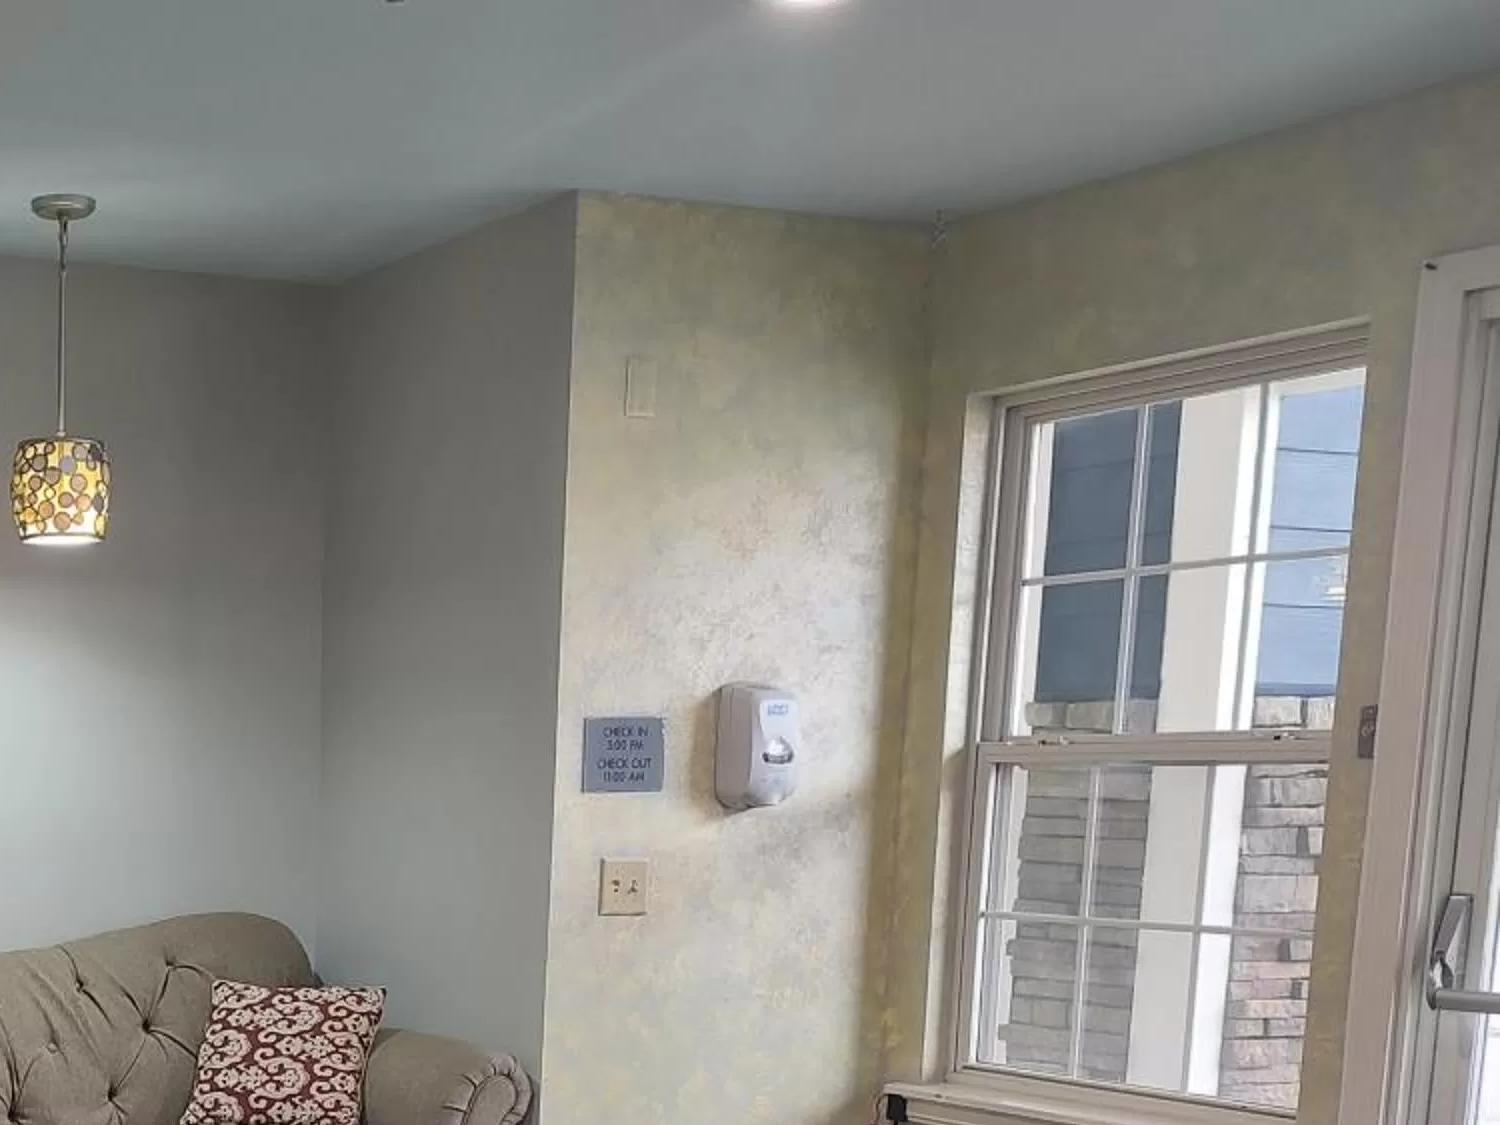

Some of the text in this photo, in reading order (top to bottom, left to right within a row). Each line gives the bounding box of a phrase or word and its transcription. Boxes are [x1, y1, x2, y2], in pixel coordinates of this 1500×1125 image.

[603, 726, 650, 737] CHECK IN
[597, 757, 652, 769] CHECK OUT
